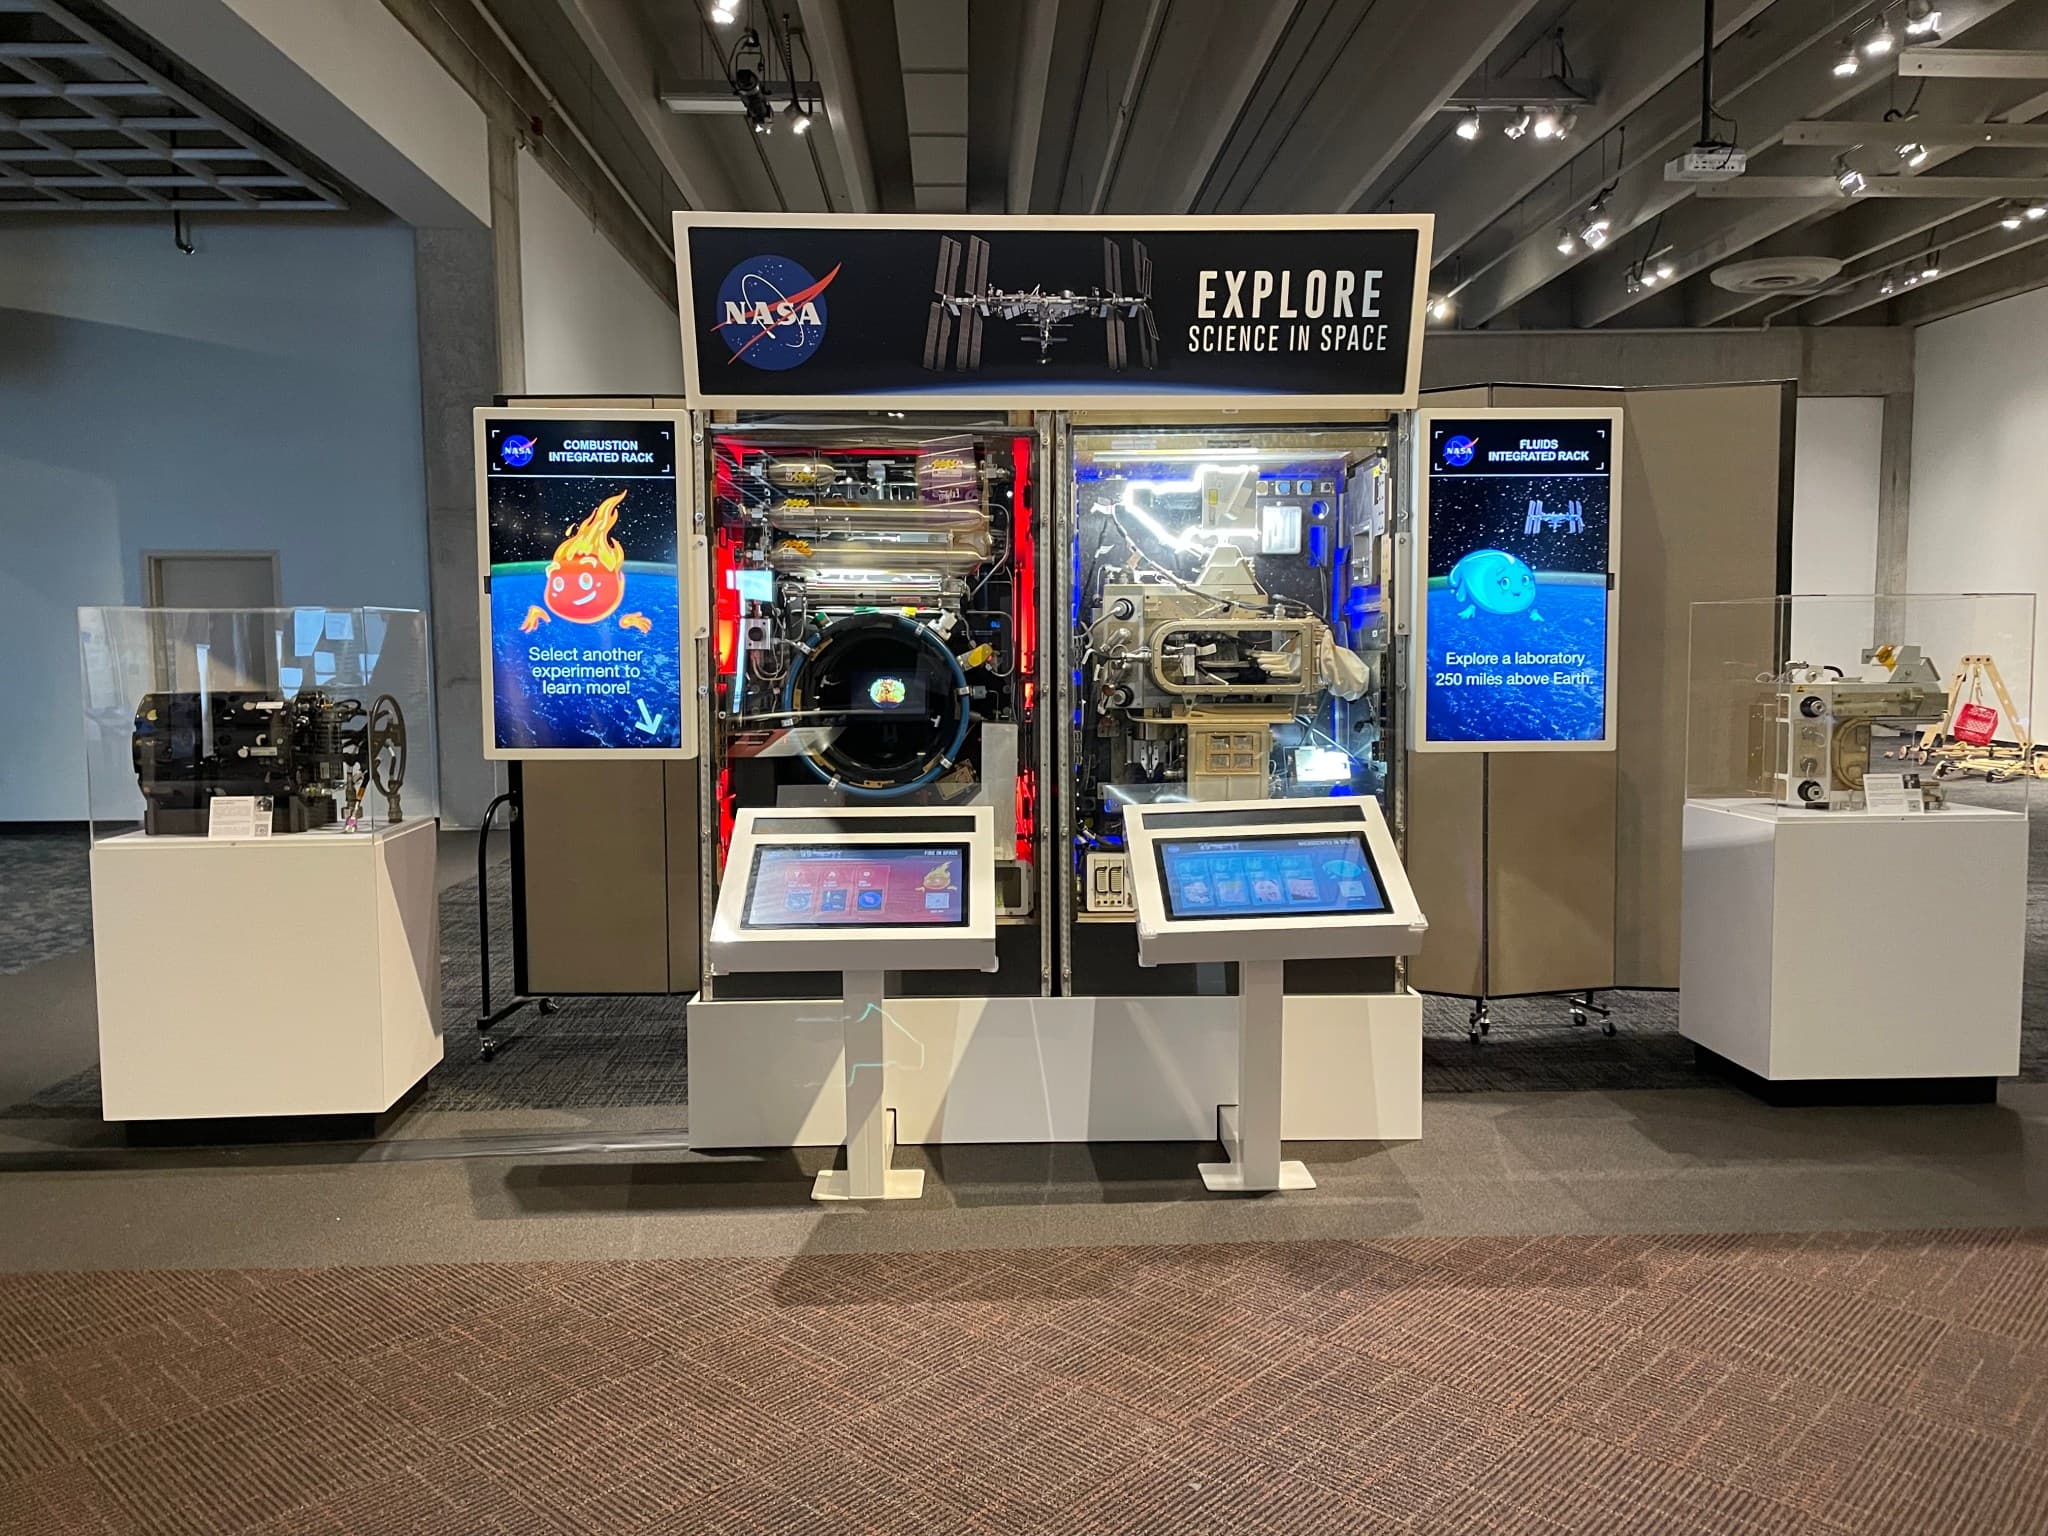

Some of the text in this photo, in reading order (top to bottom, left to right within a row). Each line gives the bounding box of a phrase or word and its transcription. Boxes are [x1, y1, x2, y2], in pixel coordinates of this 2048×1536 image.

[1198, 269, 1383, 319] EXPLORE
[724, 301, 822, 326] NASA
[1188, 324, 1388, 352] SCIENCE IN SPACE
[504, 447, 532, 456] NASA
[563, 440, 639, 451] COMBUSTION
[1446, 447, 1472, 455] NASA
[1519, 439, 1559, 450] FLUIDS
[549, 452, 654, 463] INTEGRATED RACK
[1488, 451, 1589, 462] INTEGRATED RACK
[528, 646, 643, 661] Select another
[1446, 652, 1585, 668] Explore a laboratory
[532, 664, 641, 681] experiment to
[1435, 671, 1594, 686] 250 miles above Earth.
[542, 680, 631, 695] learn more!
